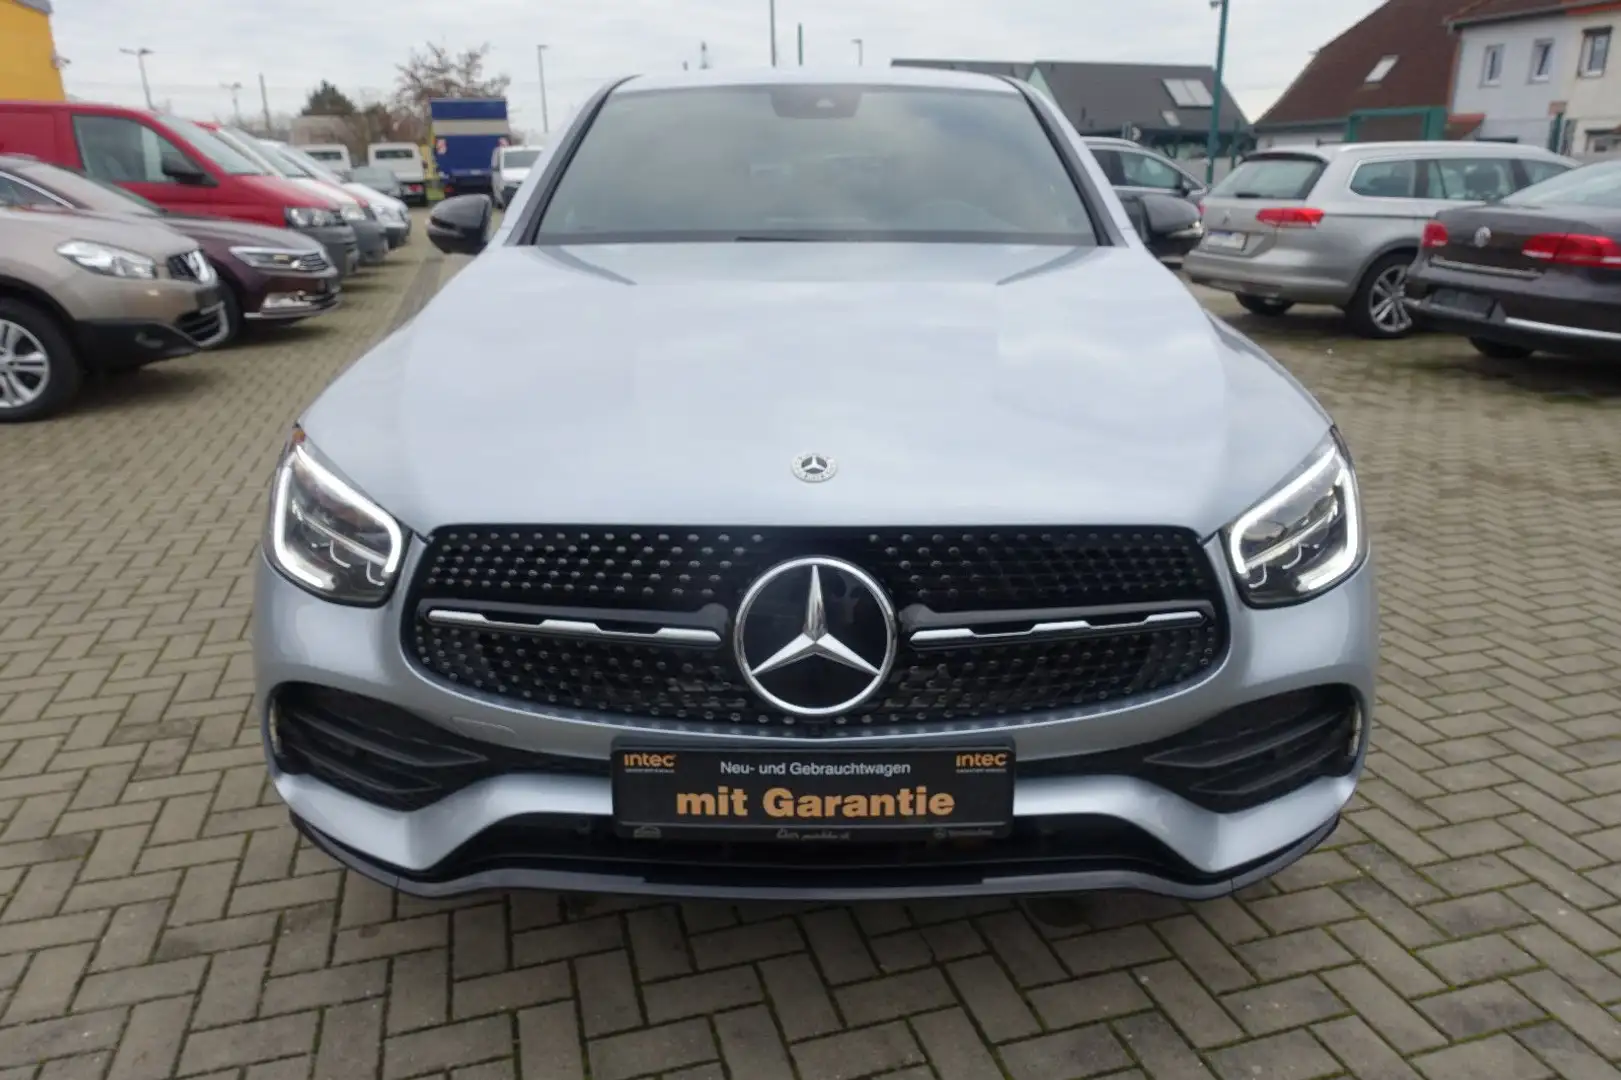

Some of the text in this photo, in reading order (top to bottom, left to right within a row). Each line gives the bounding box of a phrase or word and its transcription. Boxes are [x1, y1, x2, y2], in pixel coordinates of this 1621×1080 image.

[720, 761, 911, 777] Neu- und Gebrauchtwagen
[676, 786, 955, 817] mit Garantie
